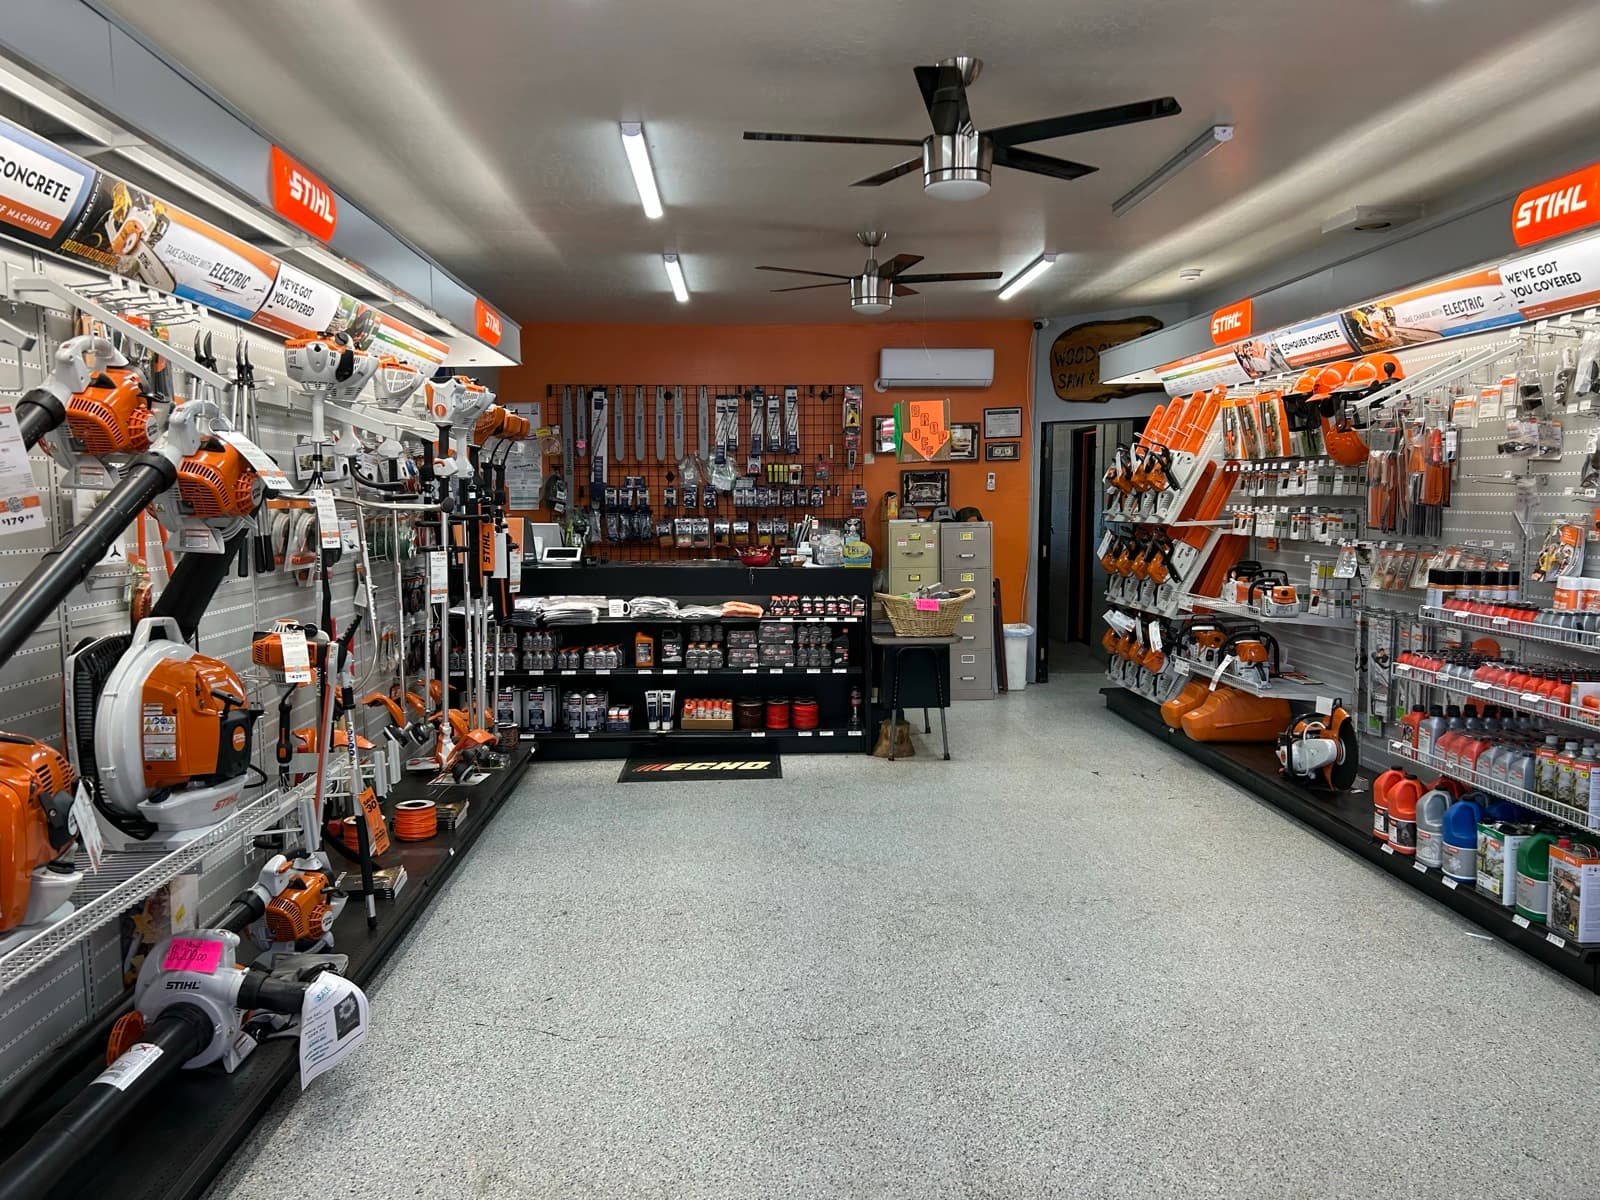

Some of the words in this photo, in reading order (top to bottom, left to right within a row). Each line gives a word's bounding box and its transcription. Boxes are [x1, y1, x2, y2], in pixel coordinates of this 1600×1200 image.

[289, 170, 335, 223] STIHL
[1516, 183, 1588, 230] STIHL
[6, 207, 52, 231] MACHINES
[209, 262, 251, 290] ELECTRIC
[1505, 268, 1537, 284] WE'VE
[1537, 261, 1559, 276] GOT
[280, 275, 300, 294] WE'VE
[299, 286, 313, 300] GOT
[1510, 285, 1533, 299] YOU
[1533, 272, 1582, 293] COVERED
[273, 291, 287, 306] YOU
[286, 297, 315, 317] COVERED
[1442, 295, 1485, 317] ELECTRIC
[484, 311, 502, 335] STIHL
[1212, 312, 1242, 335] STIHL
[1281, 338, 1308, 351] CONQUER
[1307, 329, 1340, 344] CONCRETE
[1058, 372, 1084, 389] SAW
[483, 531, 491, 564] STIHL
[662, 761, 771, 771] ECHO
[165, 981, 200, 990] STIHL
